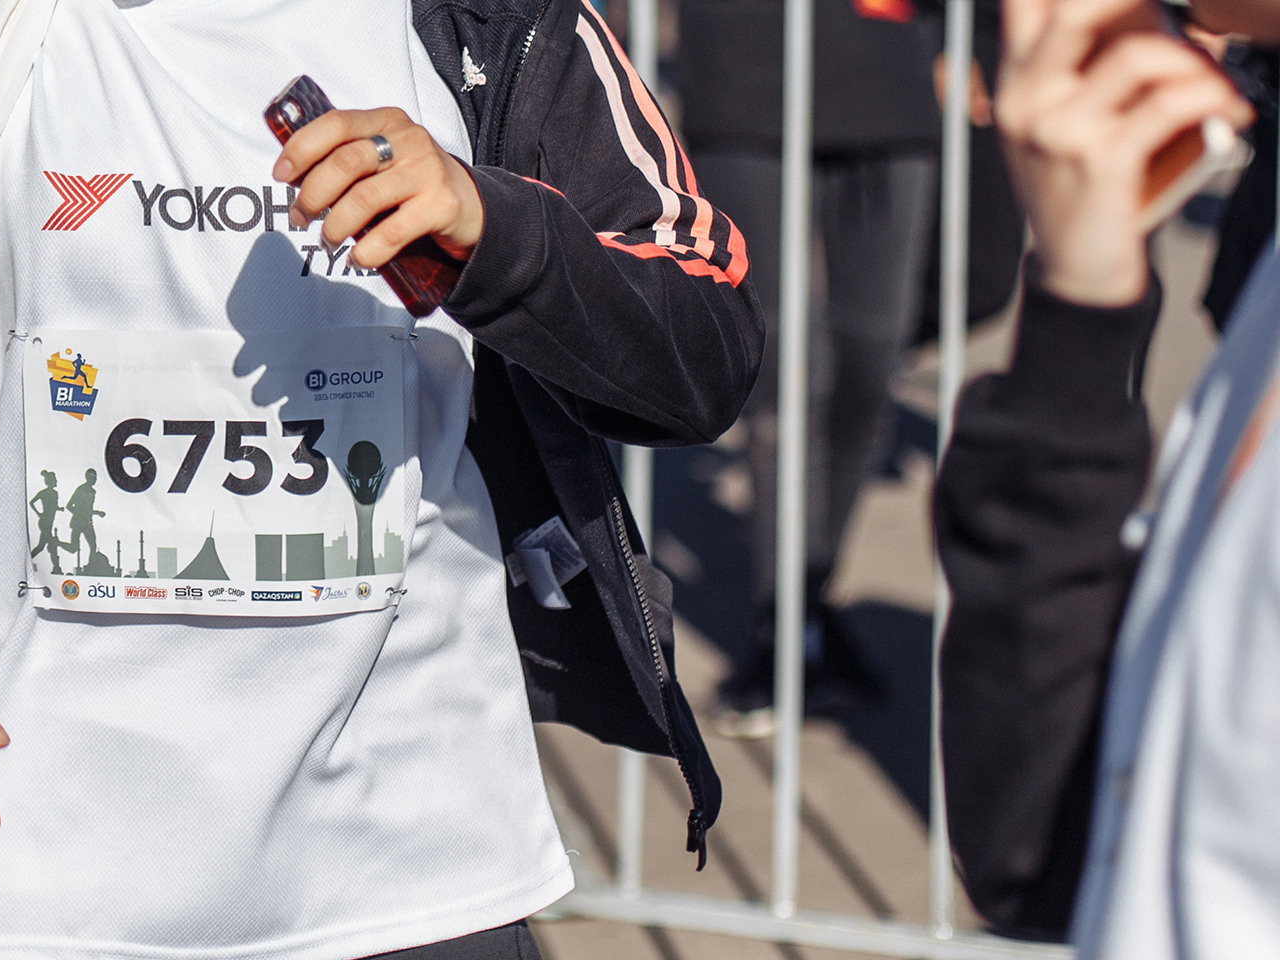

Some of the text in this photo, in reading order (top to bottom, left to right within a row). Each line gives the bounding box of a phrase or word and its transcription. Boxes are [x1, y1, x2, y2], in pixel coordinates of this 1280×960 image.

[132, 180, 332, 232] YOKOH
[309, 371, 384, 388] BI GROUP
[56, 387, 74, 401] BI
[104, 418, 329, 496] 6753
[126, 588, 166, 598] World Class
